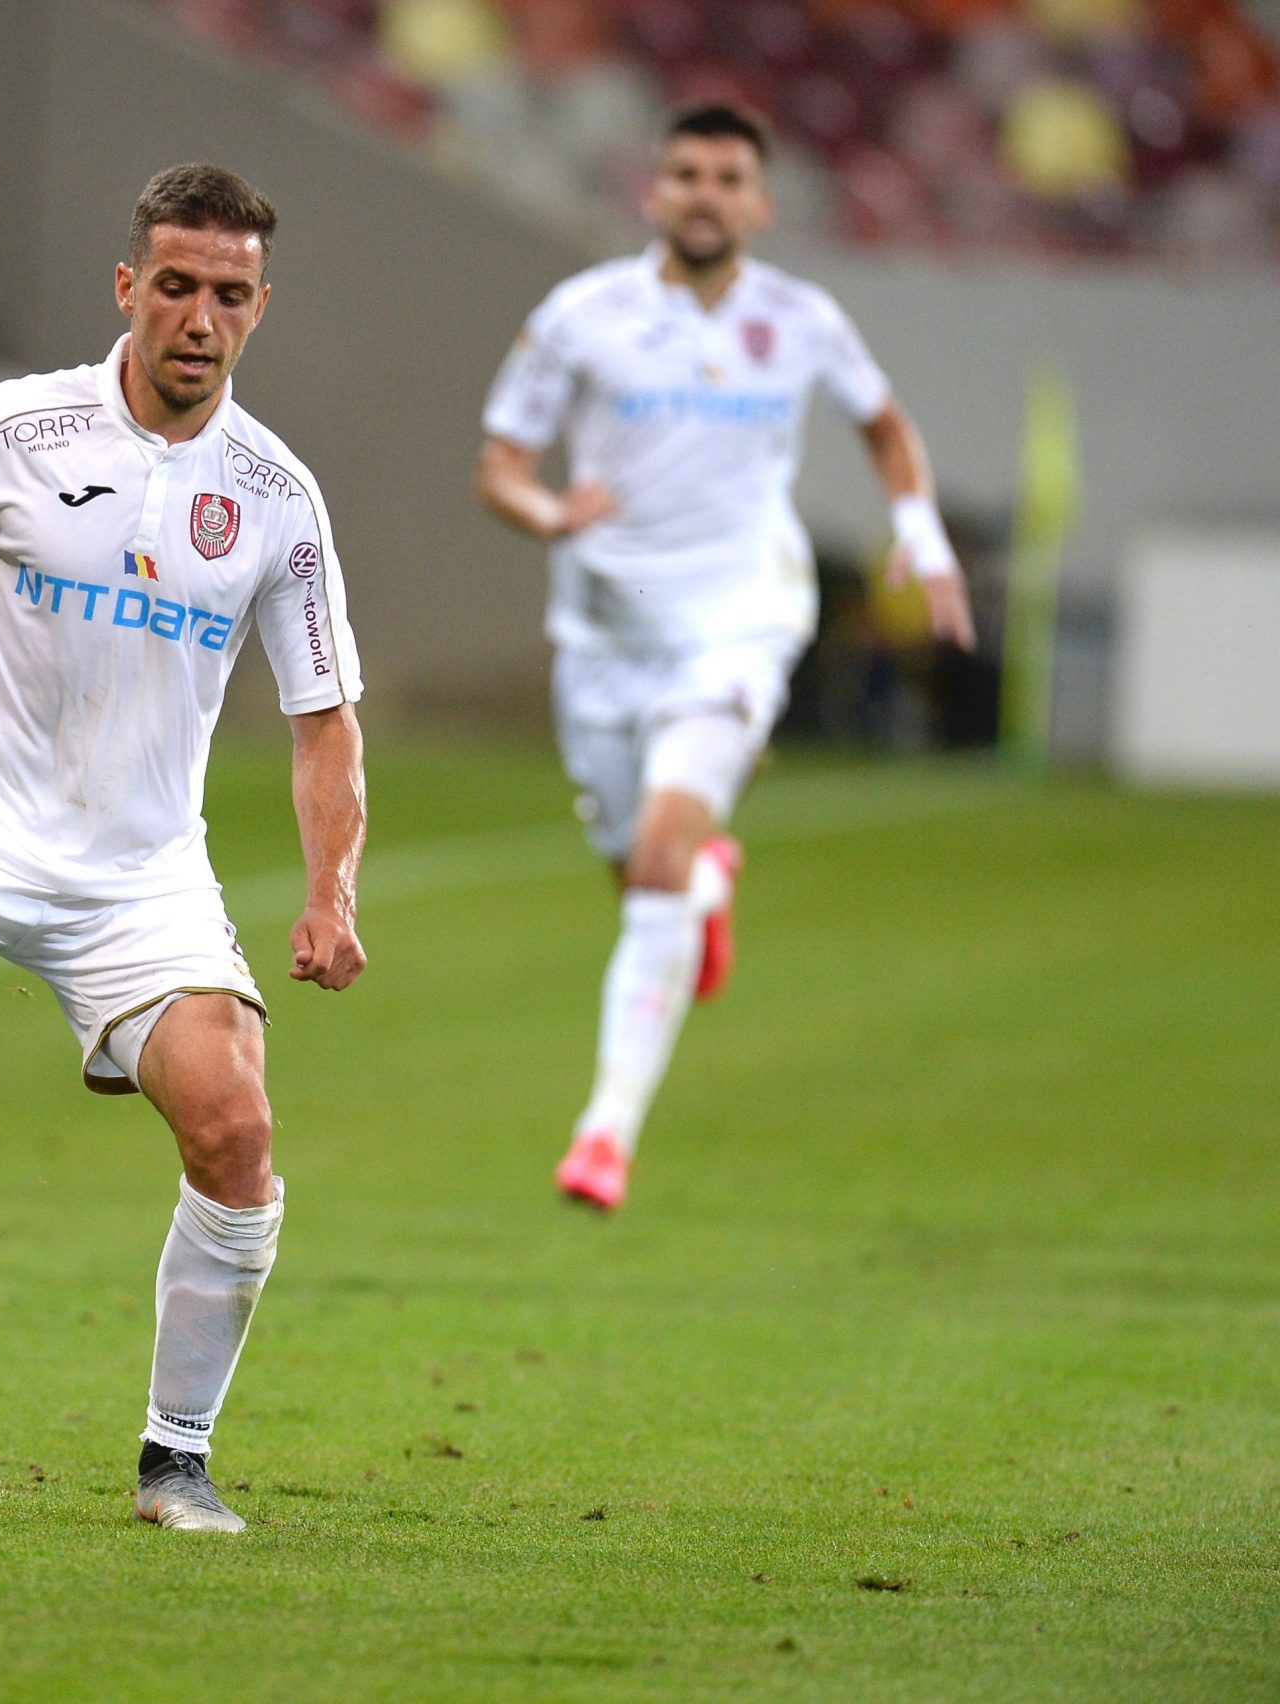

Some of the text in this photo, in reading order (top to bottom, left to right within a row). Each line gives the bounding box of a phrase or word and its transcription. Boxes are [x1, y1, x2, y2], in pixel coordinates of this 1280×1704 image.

[27, 439, 70, 454] MILANO
[224, 442, 301, 501] TORRY
[234, 475, 269, 499] MILANO
[15, 562, 110, 621] NTT
